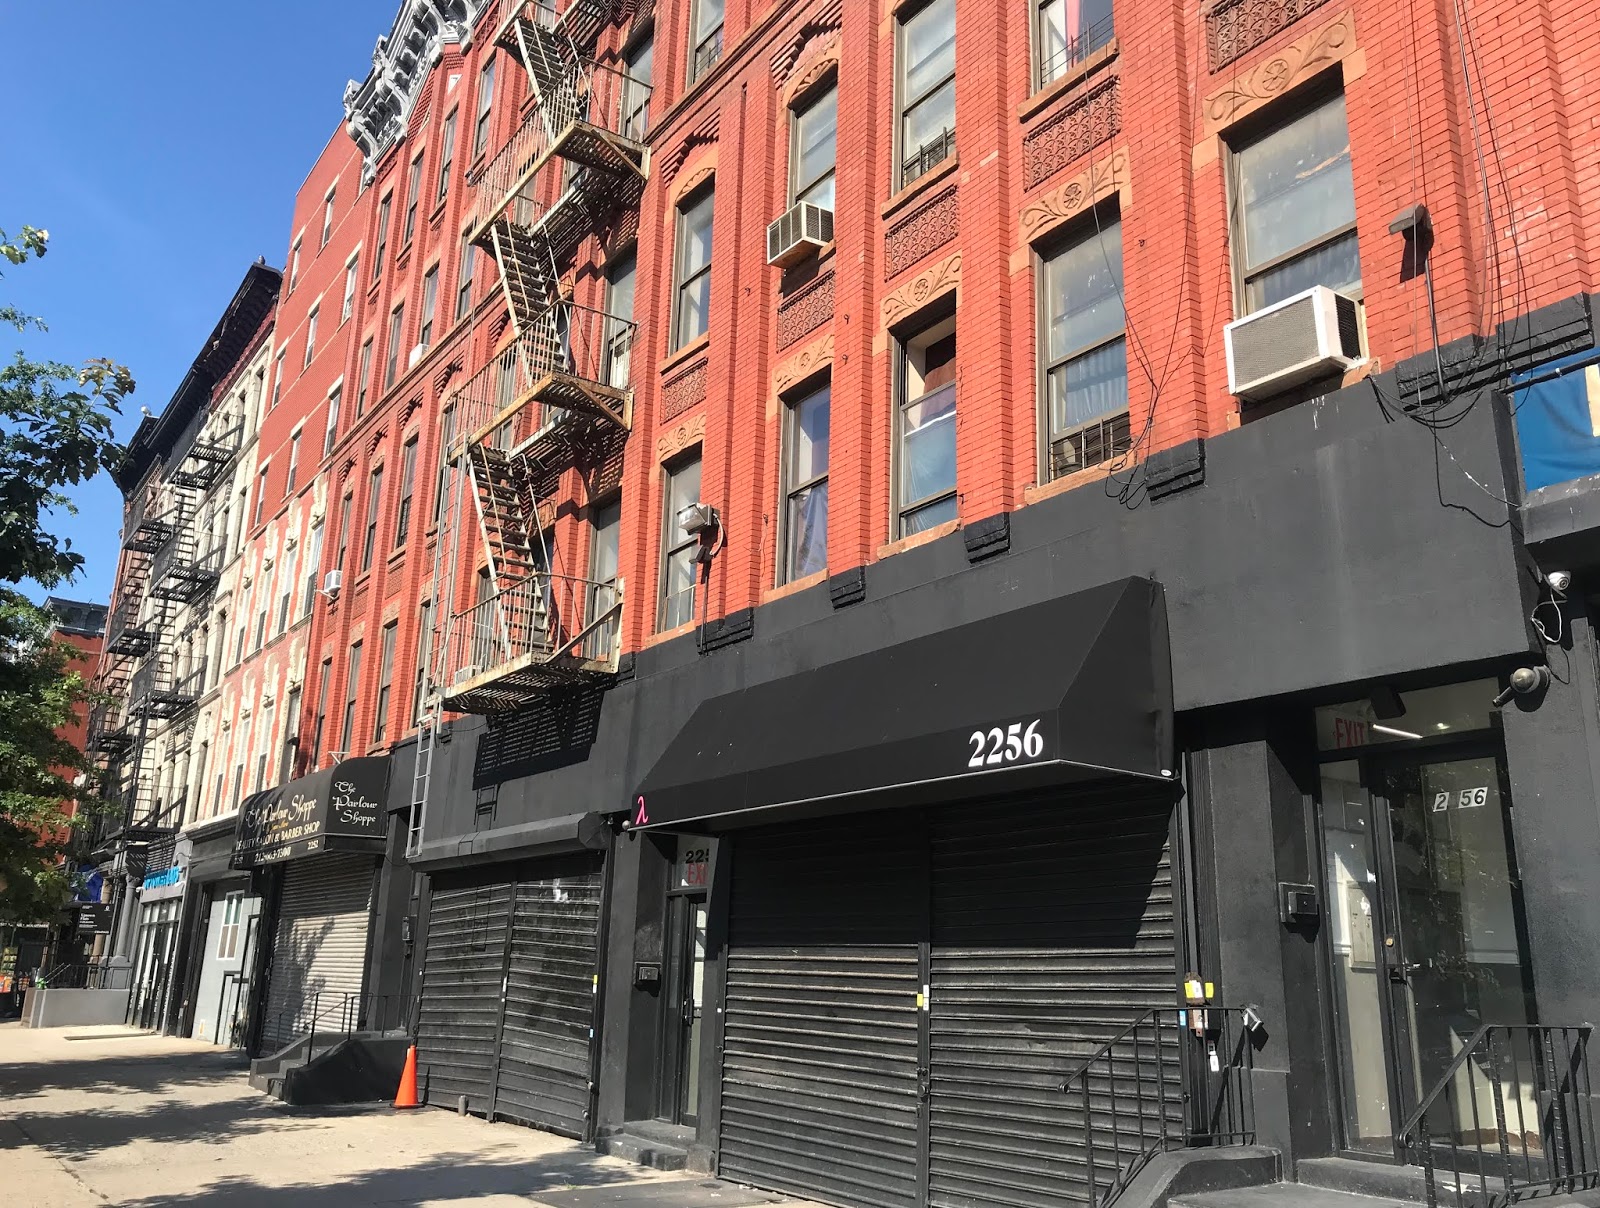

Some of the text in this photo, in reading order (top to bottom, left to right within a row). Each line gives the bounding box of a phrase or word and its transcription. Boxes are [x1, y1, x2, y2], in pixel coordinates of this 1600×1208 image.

[967, 718, 1045, 768] 2256
[1335, 717, 1366, 749] EXIT
[334, 781, 356, 795] The
[245, 794, 317, 833] The Parlour Shoppe
[332, 794, 378, 811] Parlour
[340, 810, 376, 827] Shoppe
[256, 833, 275, 847] SALON
[281, 825, 303, 841] BARBER
[303, 820, 321, 835] SHOP
